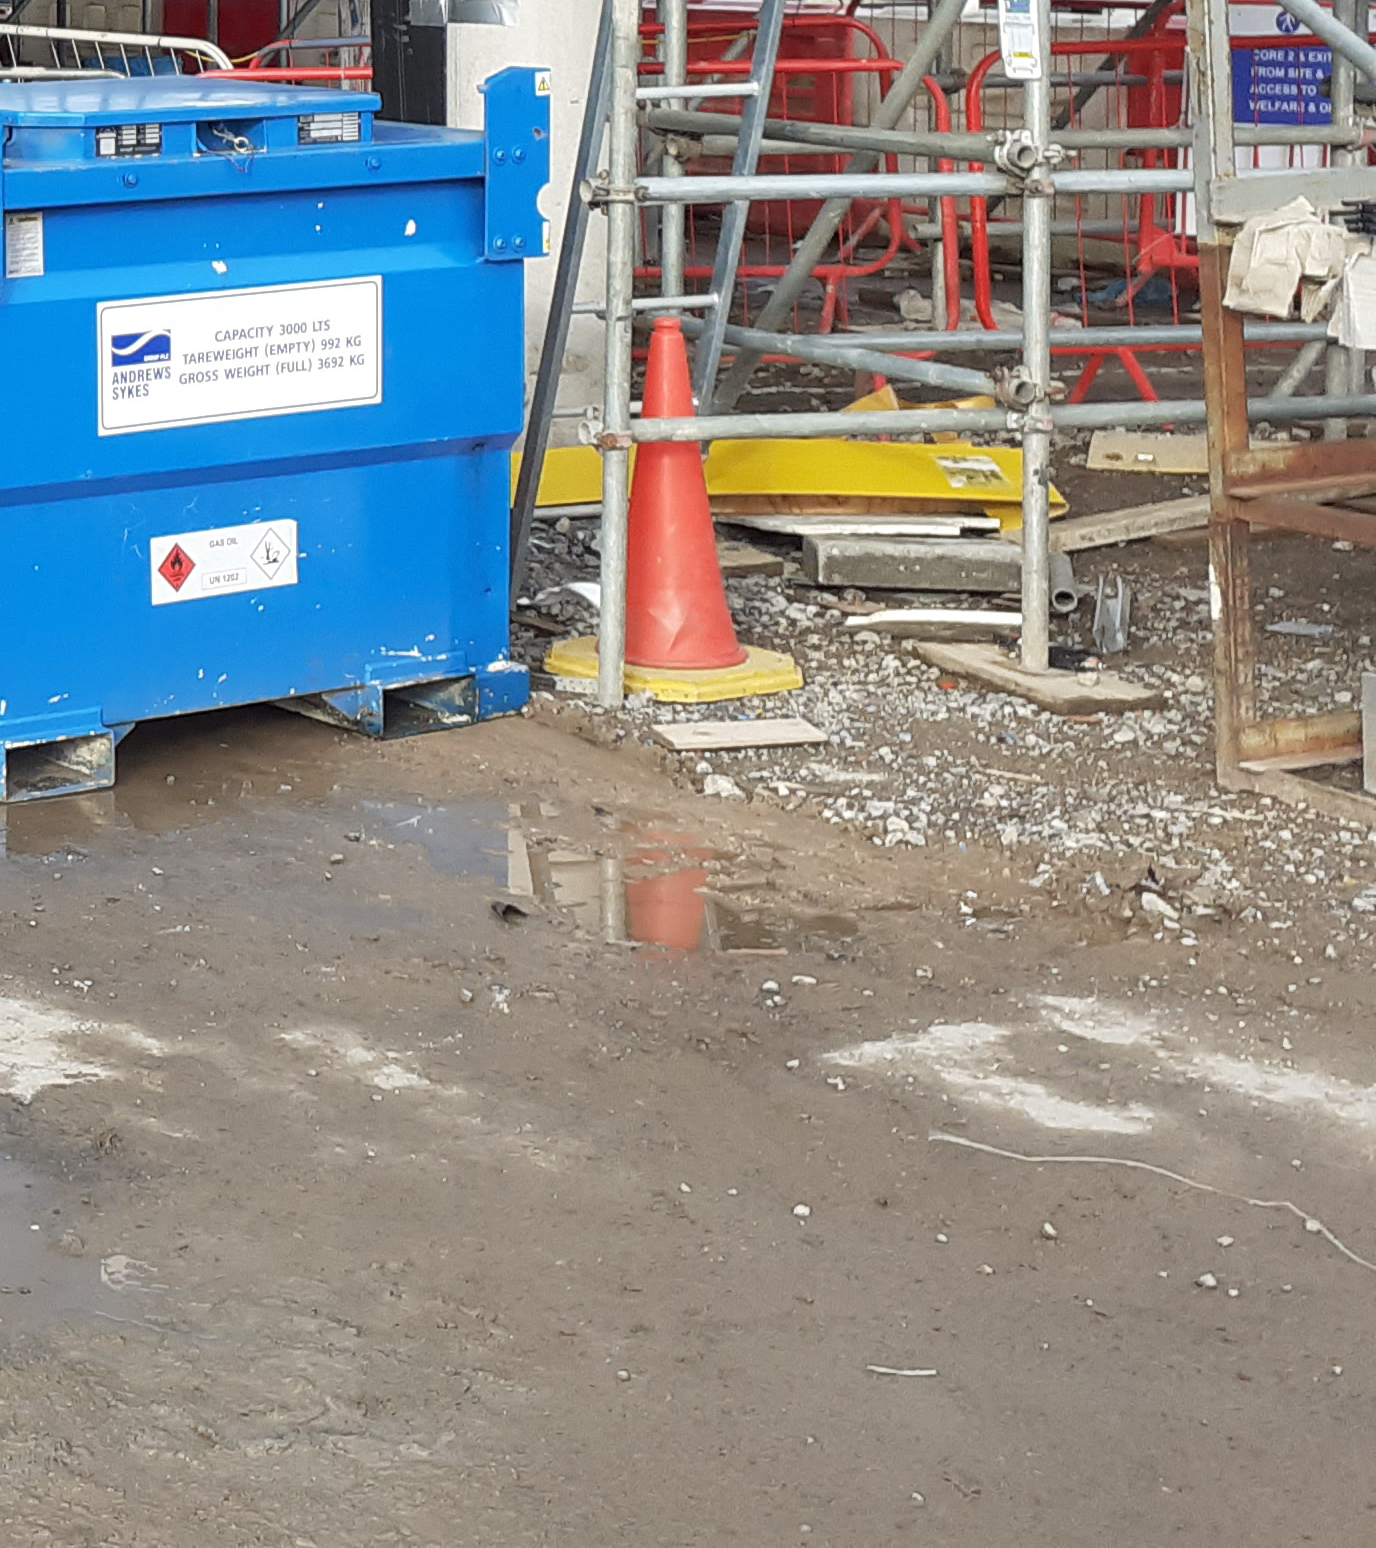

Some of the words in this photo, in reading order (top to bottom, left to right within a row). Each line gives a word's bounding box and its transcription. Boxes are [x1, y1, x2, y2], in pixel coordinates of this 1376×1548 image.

[1251, 66, 1285, 78] FROM
[1315, 68, 1324, 80] &
[1249, 83, 1298, 96] ACCESS
[1300, 84, 1317, 97] TO
[1308, 101, 1317, 114] &
[214, 325, 275, 343] CAPACITY
[279, 322, 307, 337] 3000
[312, 319, 331, 333] LTS
[182, 346, 259, 365] TAREWEIGHT
[264, 338, 316, 358] (EMPTY)
[320, 337, 341, 351] 992
[345, 335, 362, 348] KG
[111, 366, 171, 386] ANDREWS
[178, 369, 219, 385] GROSS
[224, 363, 271, 381] WEIGHT
[276, 358, 313, 376] (FULL)
[317, 355, 344, 370] 3692
[349, 353, 365, 366] KG
[111, 383, 150, 401] SYKES
[209, 538, 225, 549] GAS
[226, 537, 238, 547] OIL
[209, 576, 221, 585] UN
